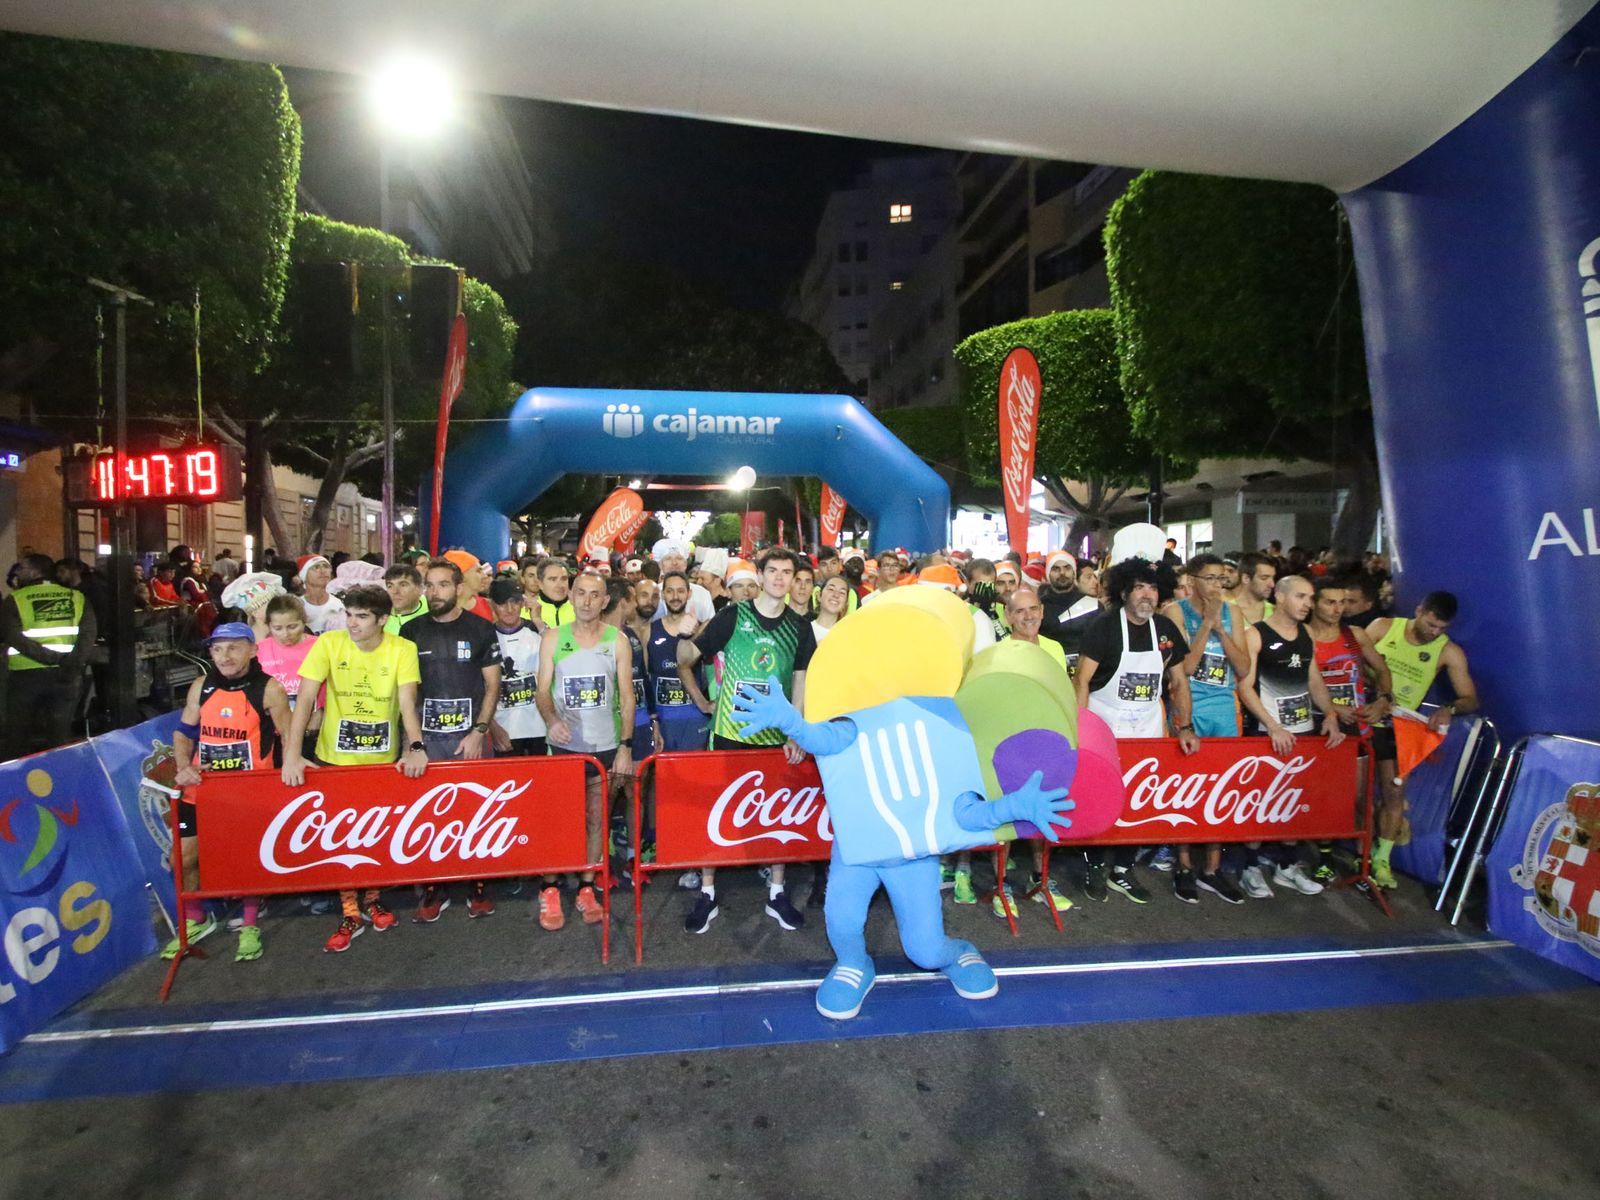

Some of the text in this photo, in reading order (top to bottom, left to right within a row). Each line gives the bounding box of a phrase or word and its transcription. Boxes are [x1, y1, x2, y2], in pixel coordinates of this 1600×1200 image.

[653, 407, 781, 441] cajamar
[1004, 358, 1036, 514] Coca-Cola
[584, 498, 632, 553] Coca-Cola
[580, 689, 598, 699] 529
[668, 690, 684, 698] 733
[438, 713, 464, 723] 1914
[201, 725, 248, 740] ALMERIA
[354, 735, 381, 744] 1897
[212, 757, 241, 770] 2187
[259, 778, 533, 875] Coca-Cola
